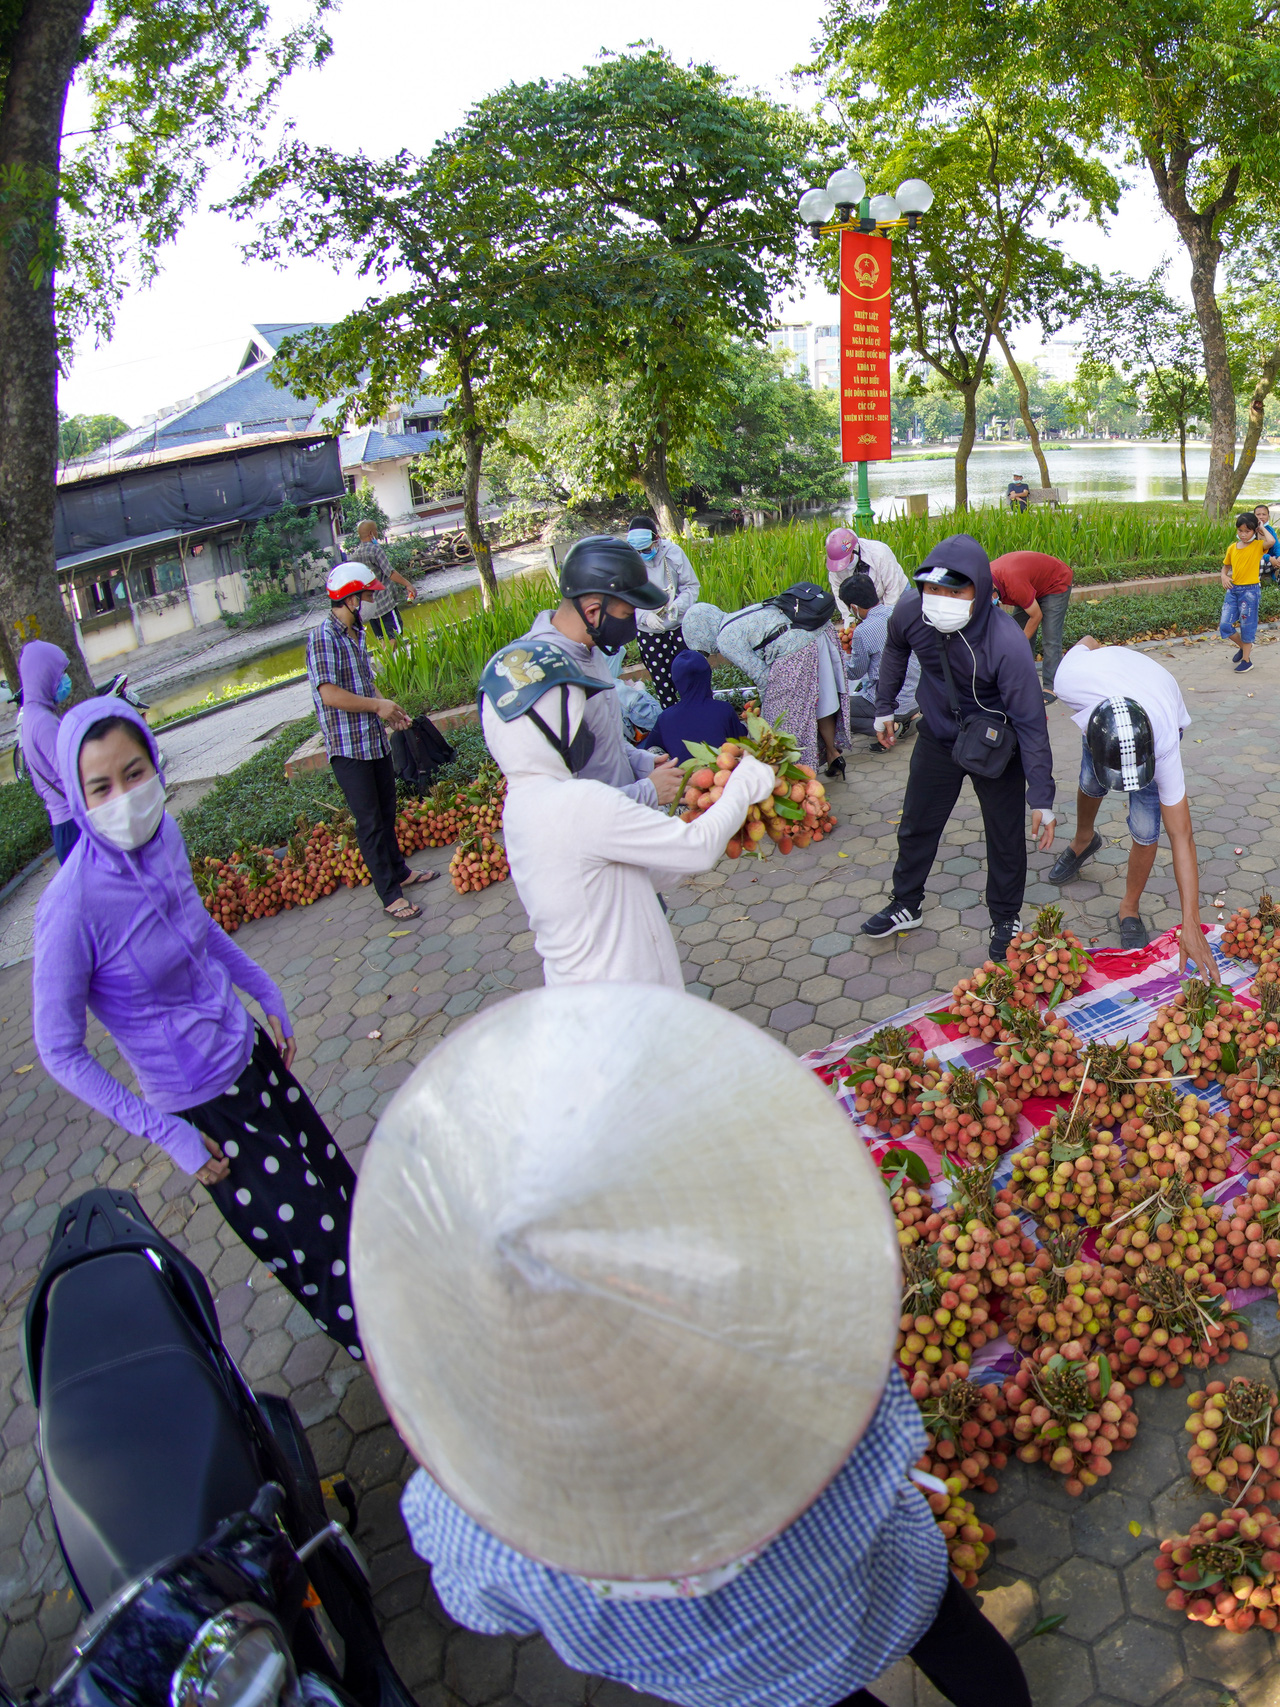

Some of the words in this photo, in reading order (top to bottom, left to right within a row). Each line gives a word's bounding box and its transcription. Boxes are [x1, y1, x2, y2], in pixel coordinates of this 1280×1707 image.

[854, 310, 868, 320] NHIỆT
[869, 311, 879, 321] LIỆT
[853, 323, 866, 332] CHÀO
[866, 324, 879, 333] MỪNG
[852, 336, 864, 345] NGÀY
[845, 349, 854, 359] ĐẠI
[855, 348, 866, 358] BIỂU
[866, 349, 878, 359] QUỐC
[879, 350, 887, 360] HỘI
[857, 362, 869, 371] KHÓA
[853, 375, 860, 384] VÀ
[860, 376, 869, 385] ĐẠI
[869, 375, 880, 385] BIỂU
[844, 388, 852, 398] HỘI
[853, 388, 866, 397] ĐỒNG
[867, 388, 879, 398] NHÂN
[879, 389, 888, 398] DÂN
[857, 401, 866, 411] CÁC
[867, 401, 876, 411] CẤP
[844, 413, 857, 422] NHIỆM
